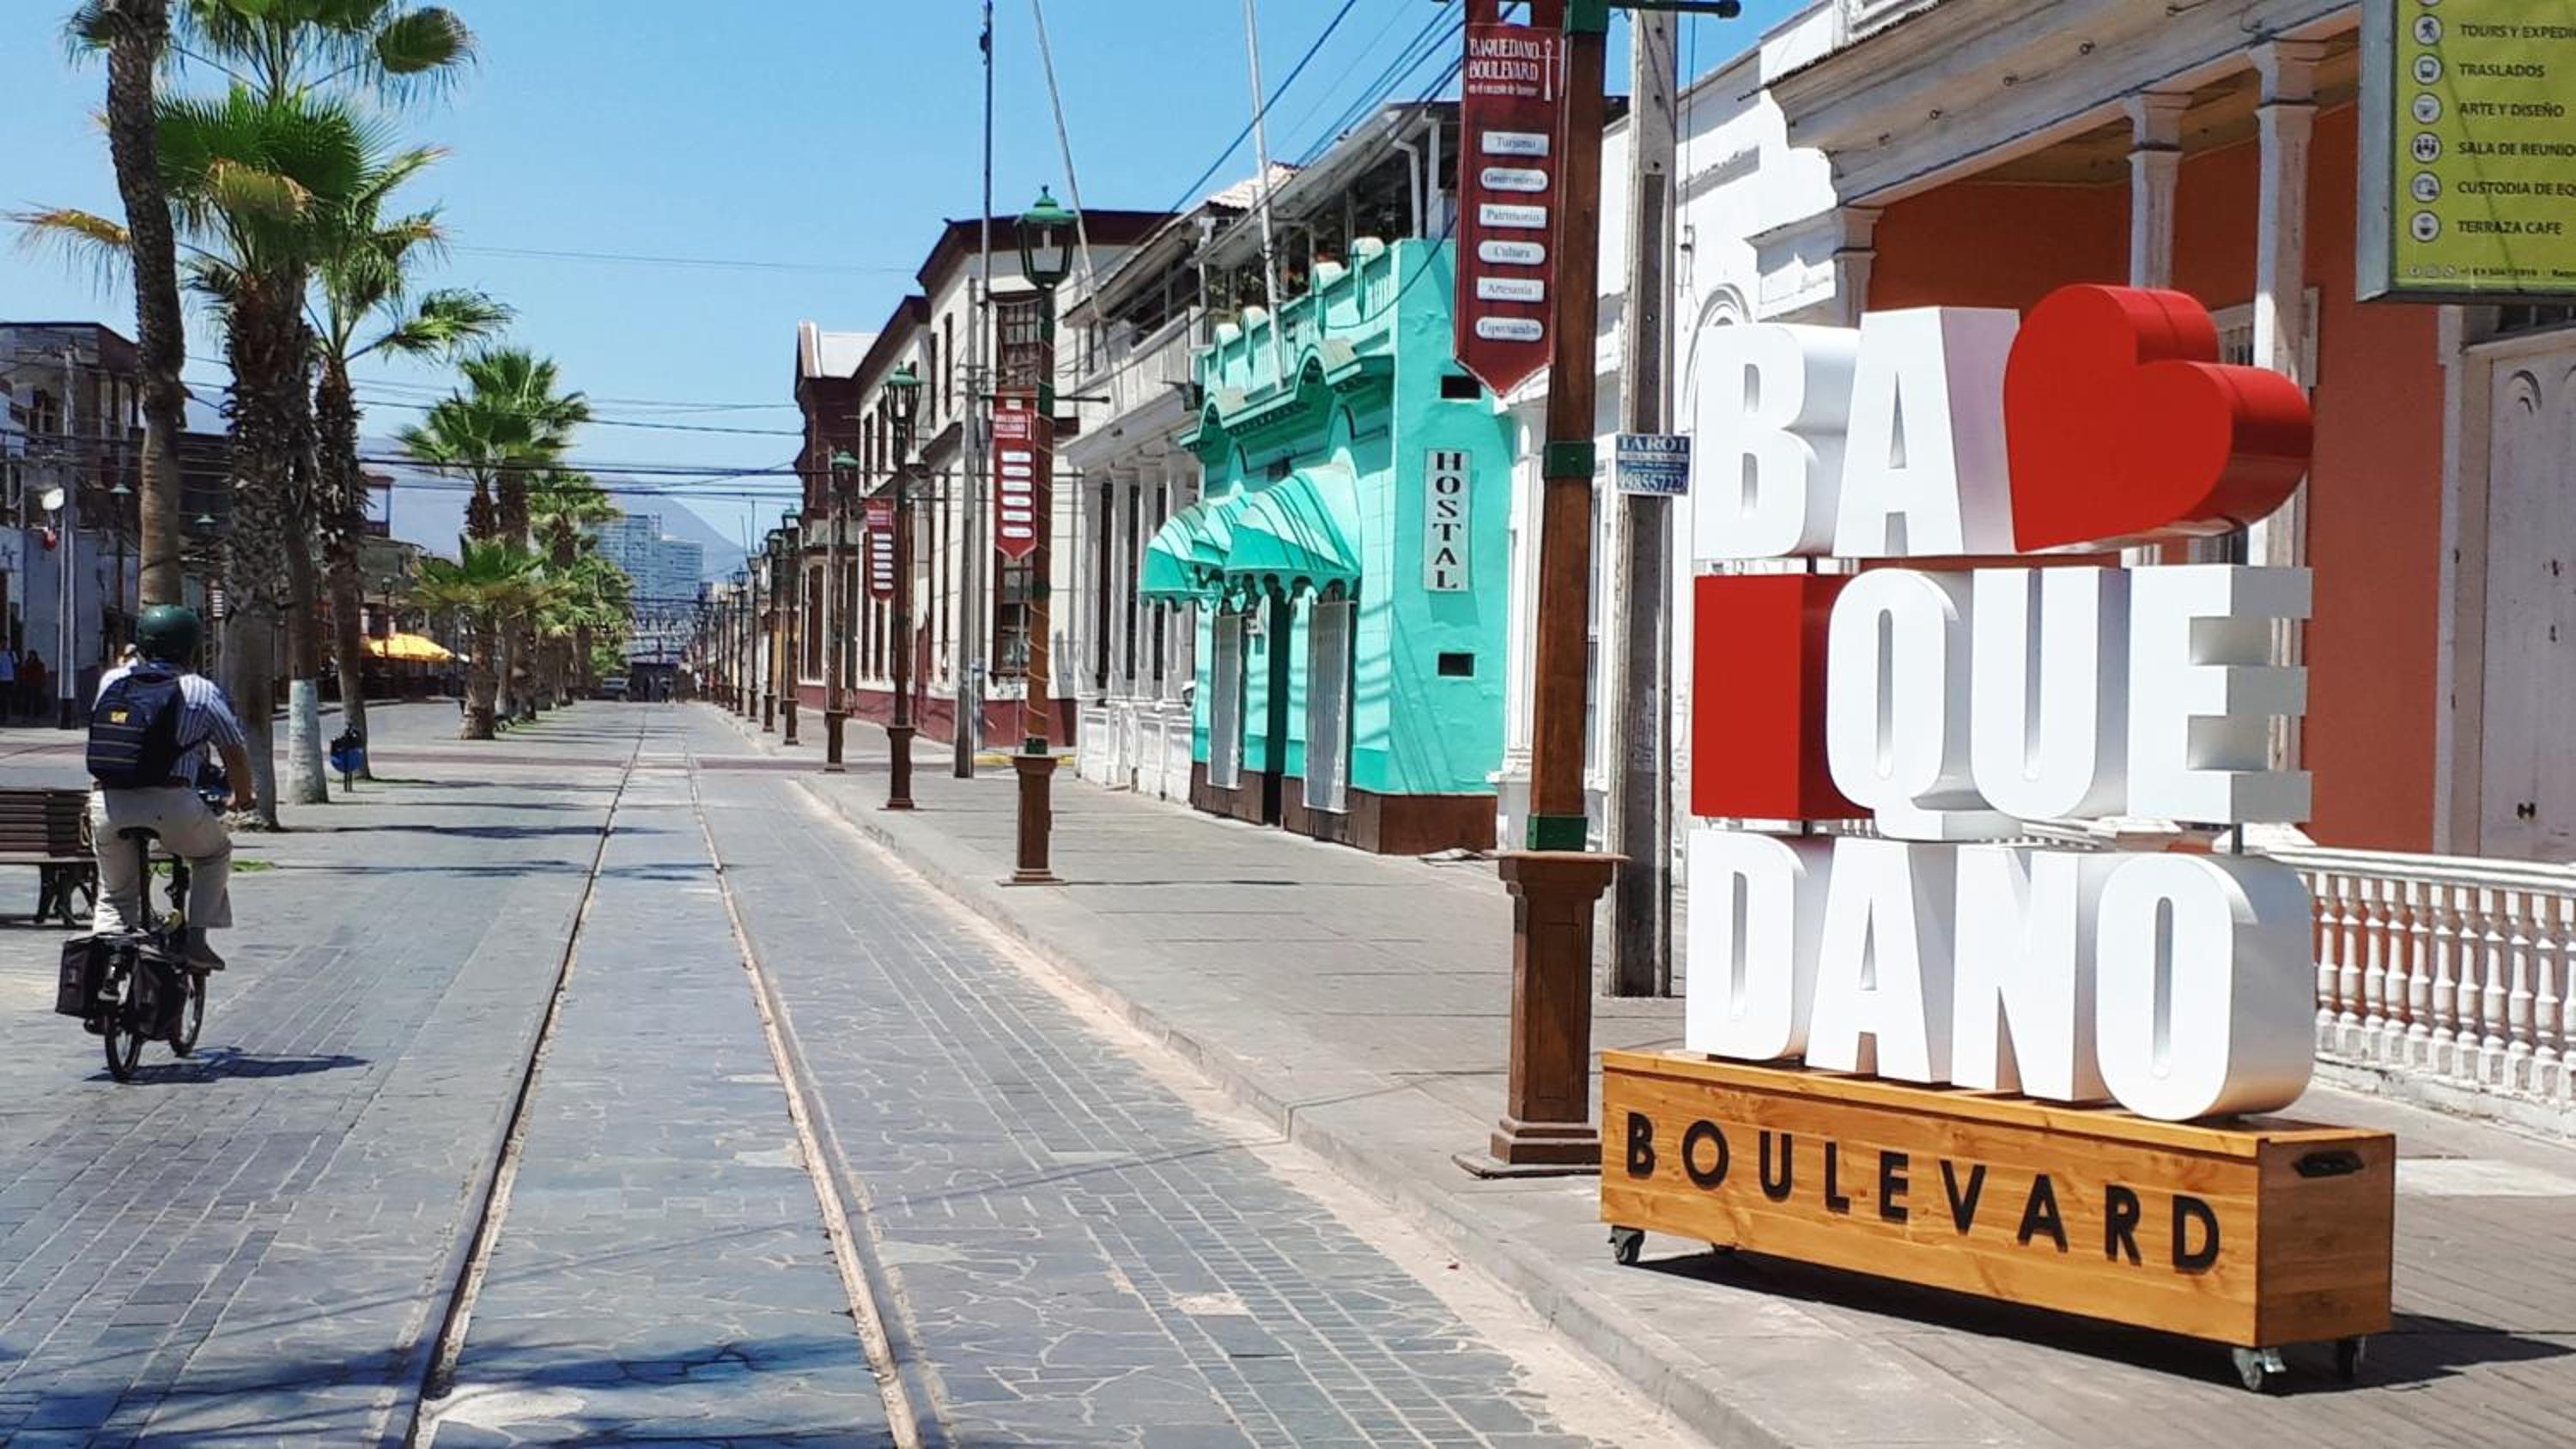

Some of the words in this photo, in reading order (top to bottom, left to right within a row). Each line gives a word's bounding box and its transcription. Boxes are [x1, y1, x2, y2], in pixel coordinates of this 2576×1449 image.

[2459, 23, 2506, 38] TOURS
[2508, 25, 2519, 38] Y
[1468, 38, 1540, 60] BAQUEDANO
[1468, 60, 1540, 82] BOULEVARD
[2458, 63, 2545, 78] TRASLADOS
[2459, 102, 2496, 116] ARTE
[2498, 104, 2507, 116] Y
[2510, 101, 2565, 118] DISEÑO
[2458, 142, 2495, 155] SALA
[2498, 142, 2517, 155] DE
[2458, 180, 2530, 195] CUSTODIA
[2534, 182, 2554, 196] DE
[1486, 209, 1540, 221] Patrimonio
[2458, 220, 2523, 234] TERRAZA
[1493, 246, 1532, 259] Cultura
[1620, 435, 1687, 452] TAROT
[1432, 452, 1463, 590] HOSTAL
[1826, 564, 2313, 842] QUE
[1686, 828, 2316, 1122] DANO
[1625, 1110, 2221, 1273] BOULEVARD
